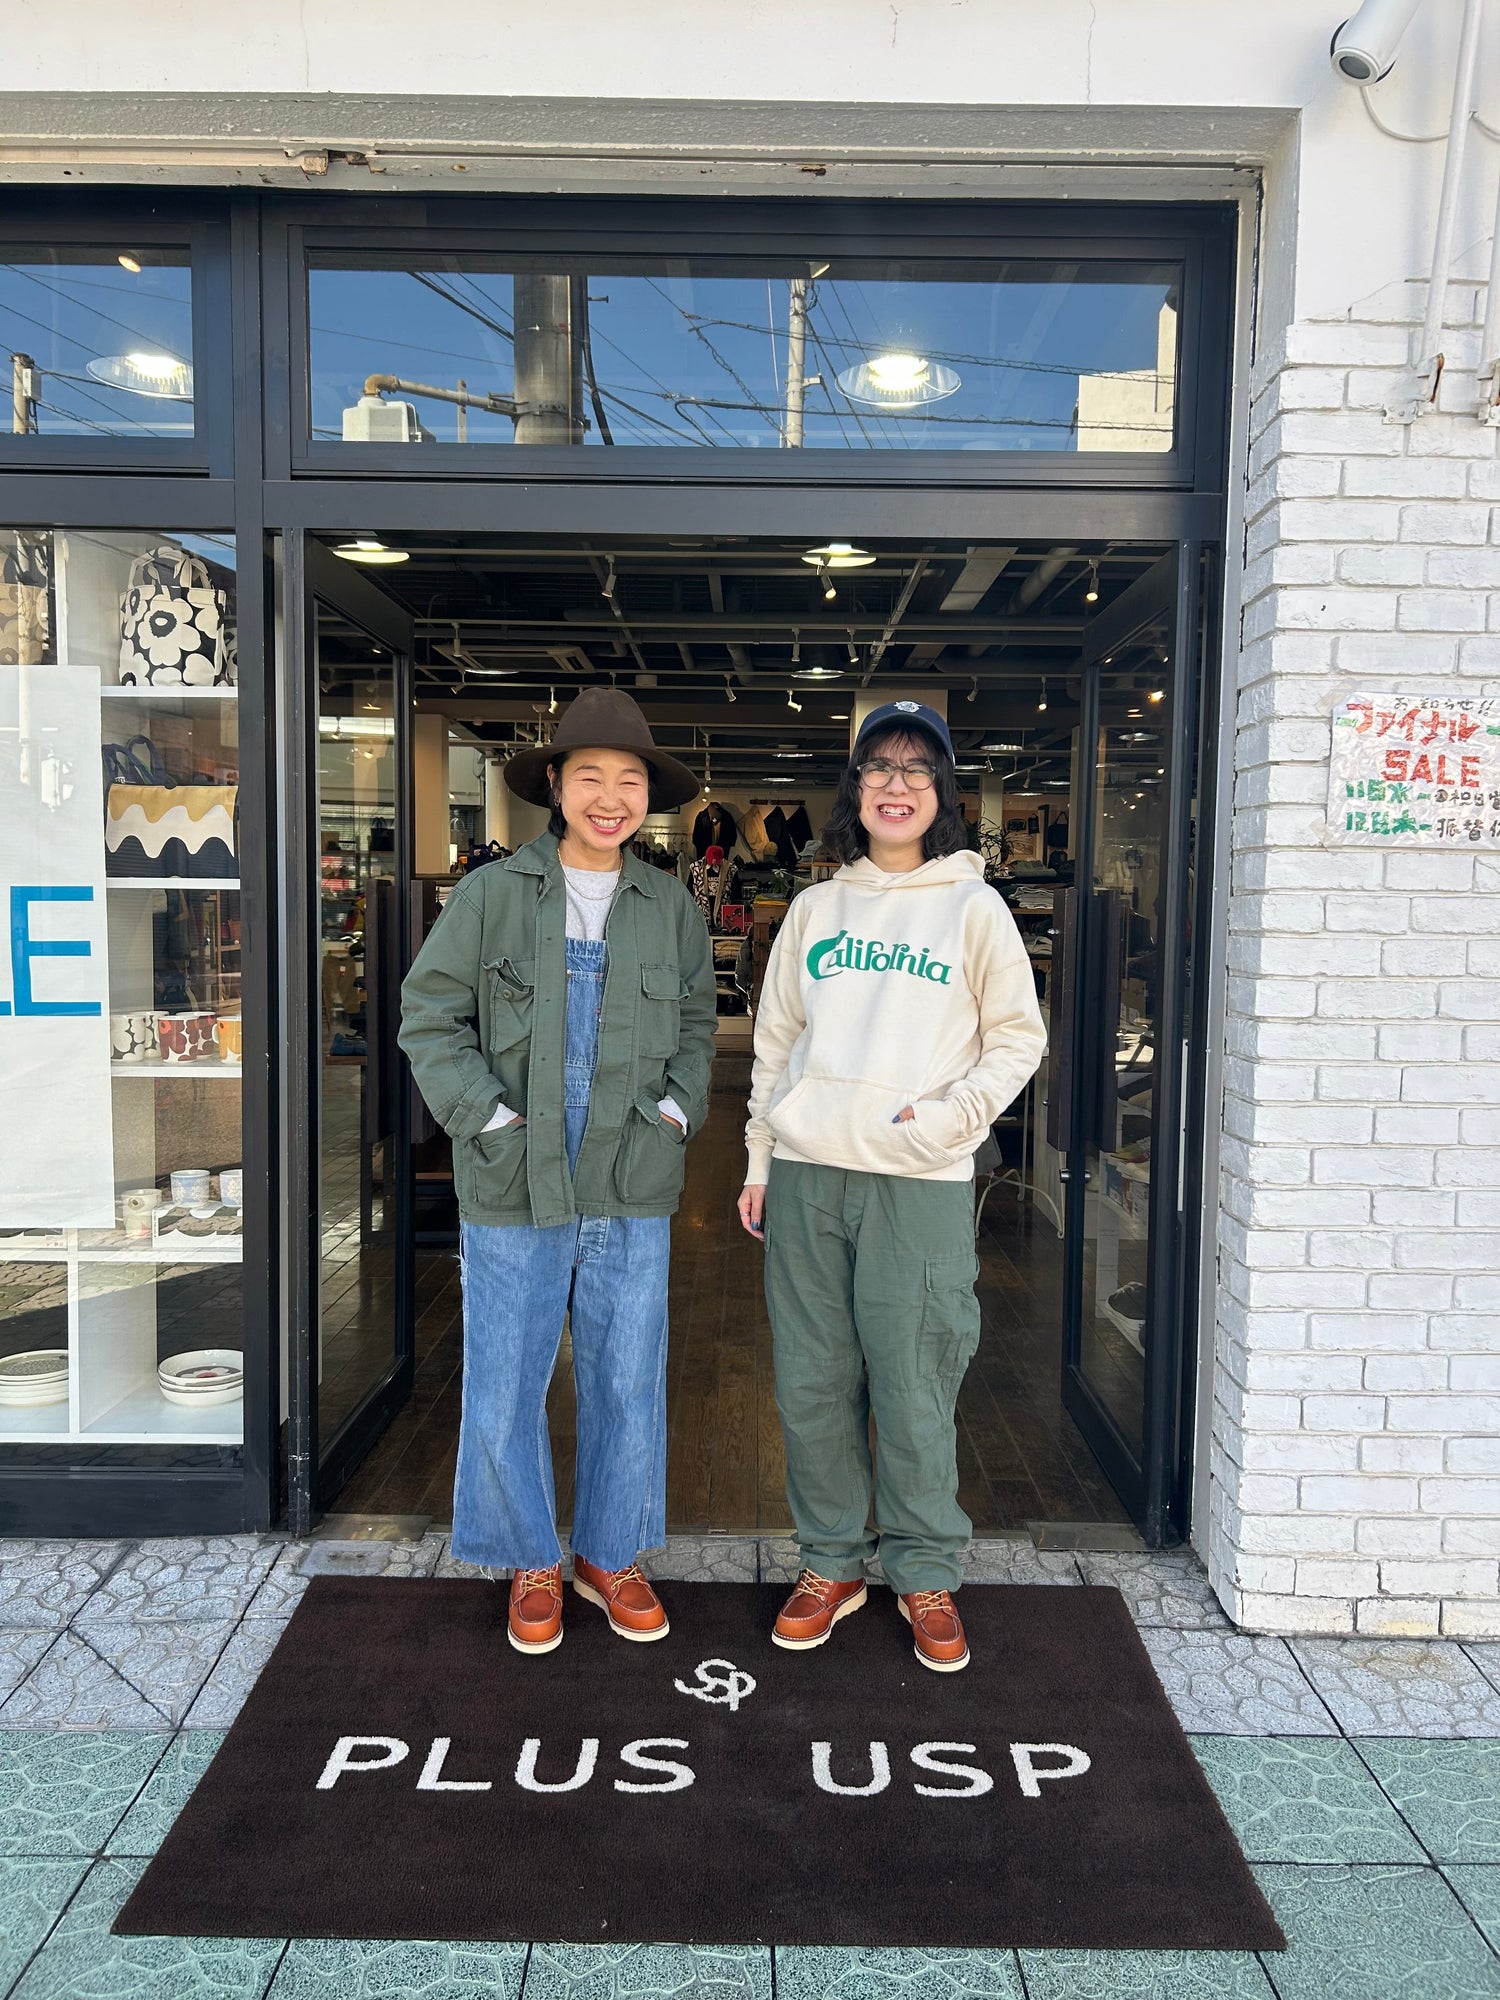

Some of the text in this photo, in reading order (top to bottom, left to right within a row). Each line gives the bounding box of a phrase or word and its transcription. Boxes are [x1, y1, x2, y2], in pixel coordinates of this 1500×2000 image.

[1346, 703, 1481, 746] ファイナル
[1381, 749, 1481, 788] SALE
[0, 886, 102, 1016] E
[806, 930, 952, 985] California
[315, 1736, 1093, 1798] PLUS USP
